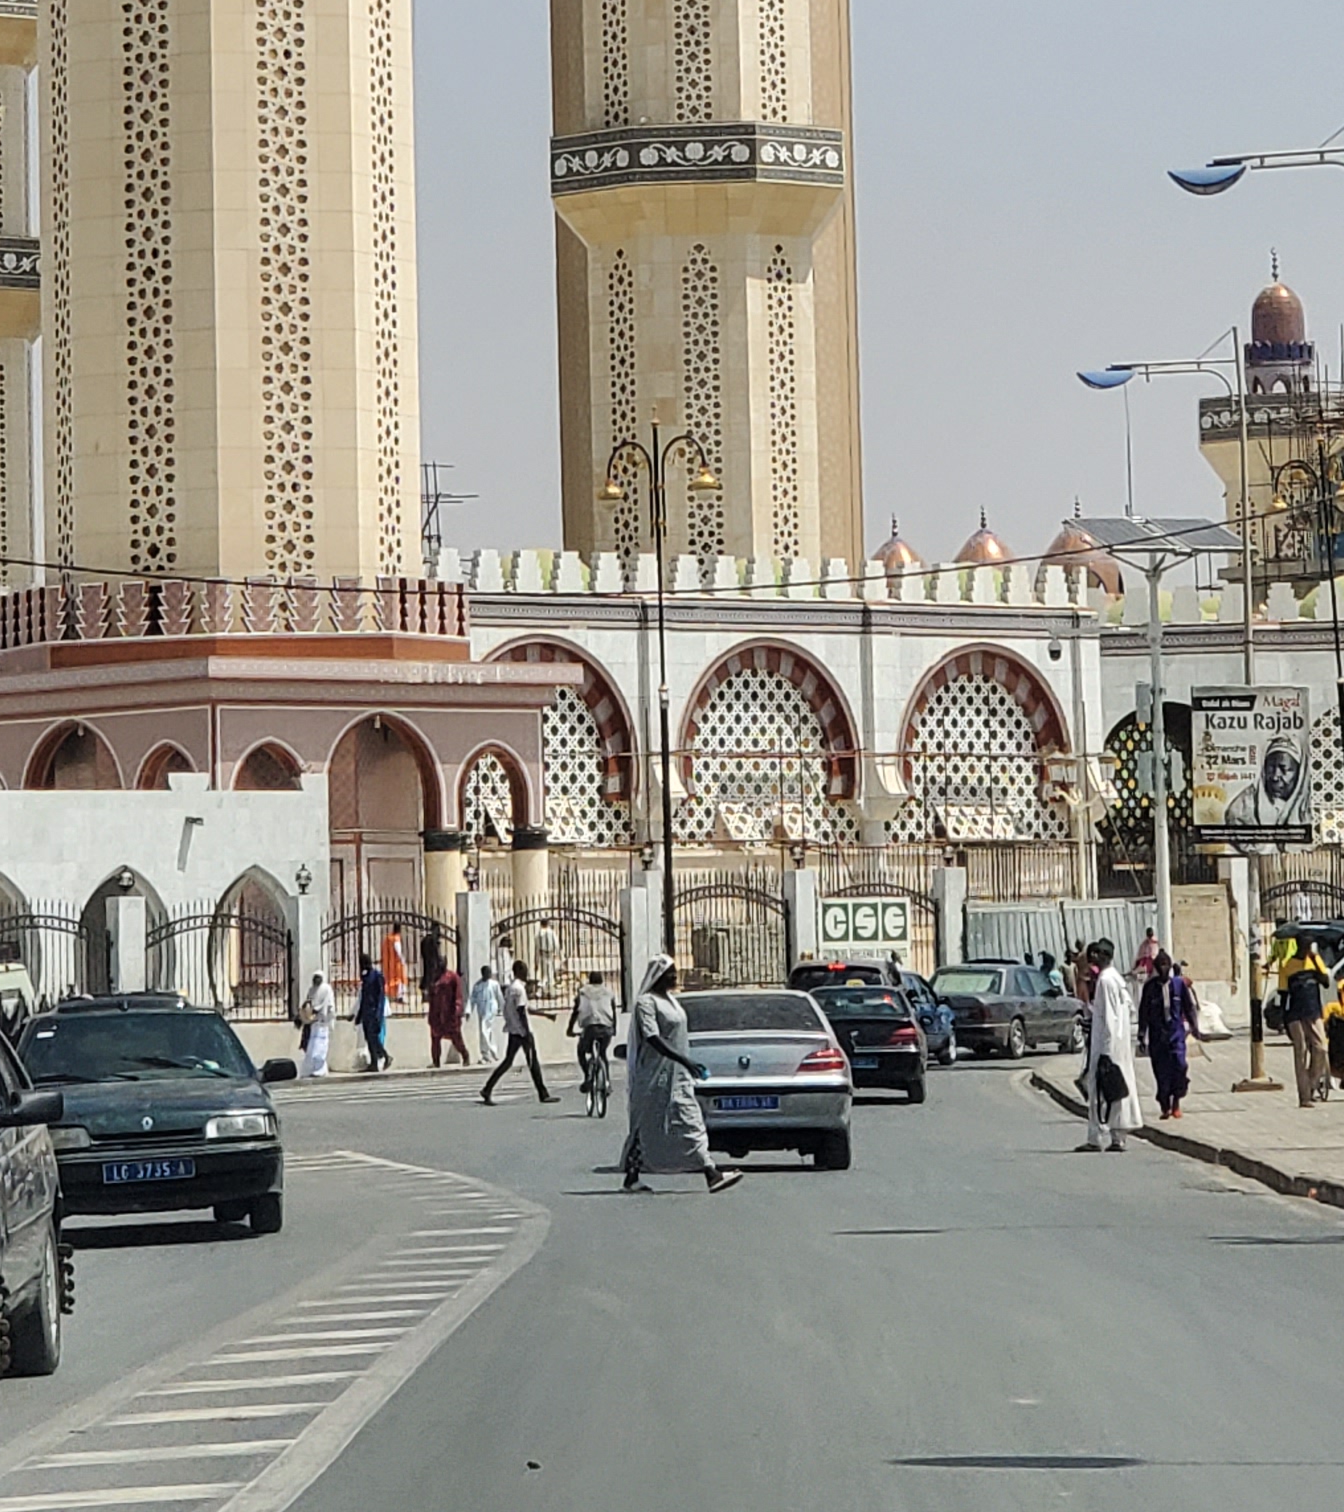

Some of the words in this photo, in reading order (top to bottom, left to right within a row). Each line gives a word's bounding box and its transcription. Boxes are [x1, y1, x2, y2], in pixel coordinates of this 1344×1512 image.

[1263, 693, 1300, 712] Magal
[1205, 713, 1247, 730] Kazu
[1253, 711, 1304, 734] Rajab
[1221, 754, 1247, 765] Mars
[825, 906, 905, 938] CSE
